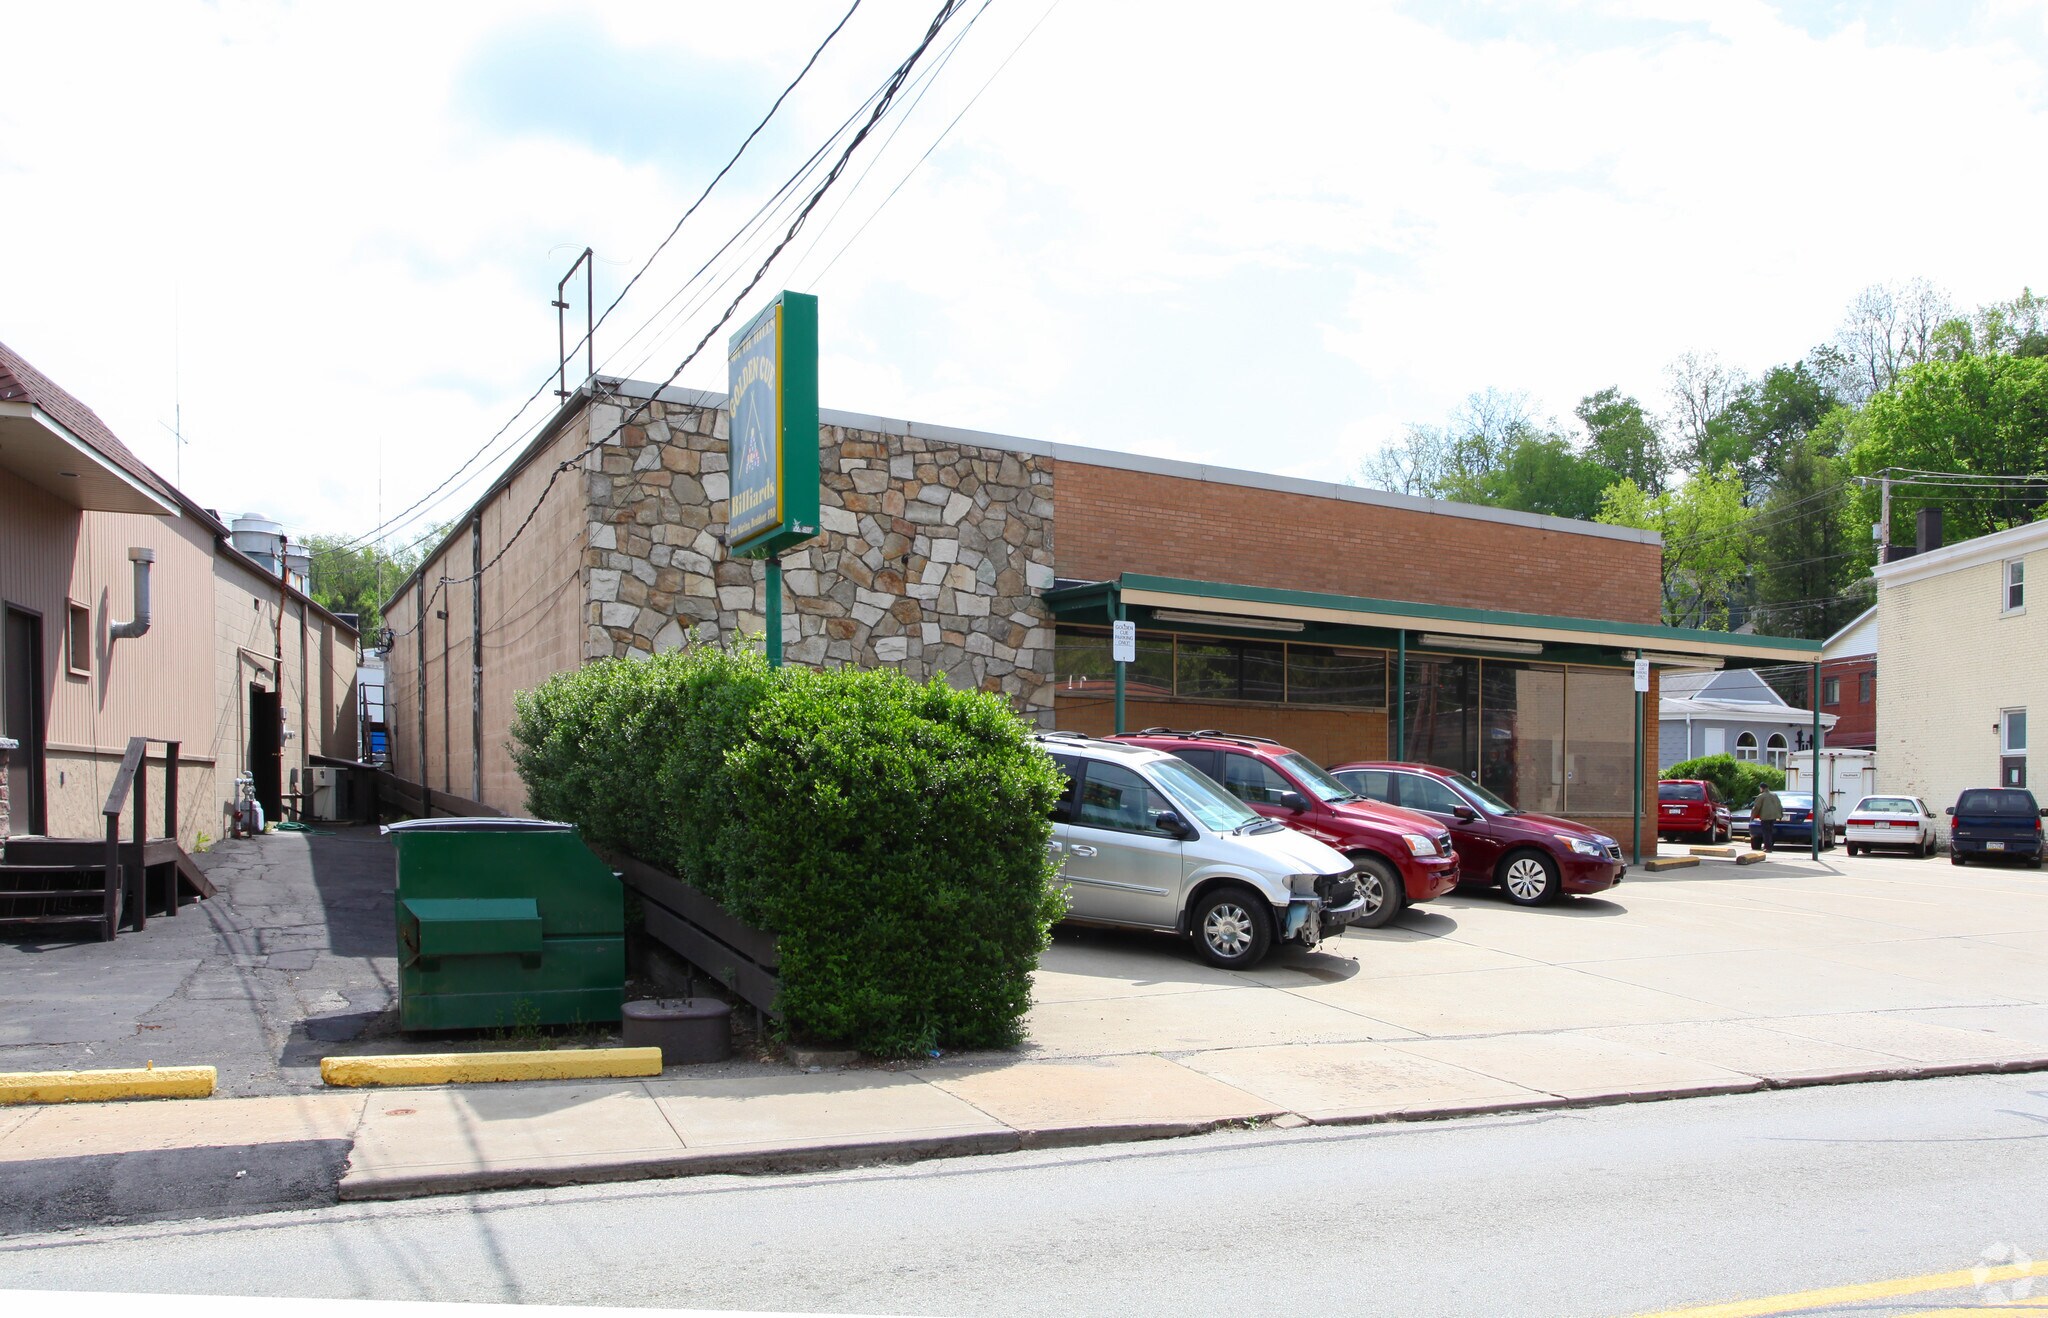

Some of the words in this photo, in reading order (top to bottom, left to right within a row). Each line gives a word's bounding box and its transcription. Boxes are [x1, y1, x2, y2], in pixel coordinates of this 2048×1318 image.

[730, 356, 759, 419] GOLDEN
[760, 356, 775, 390] CUE
[731, 477, 775, 518] Billiards
